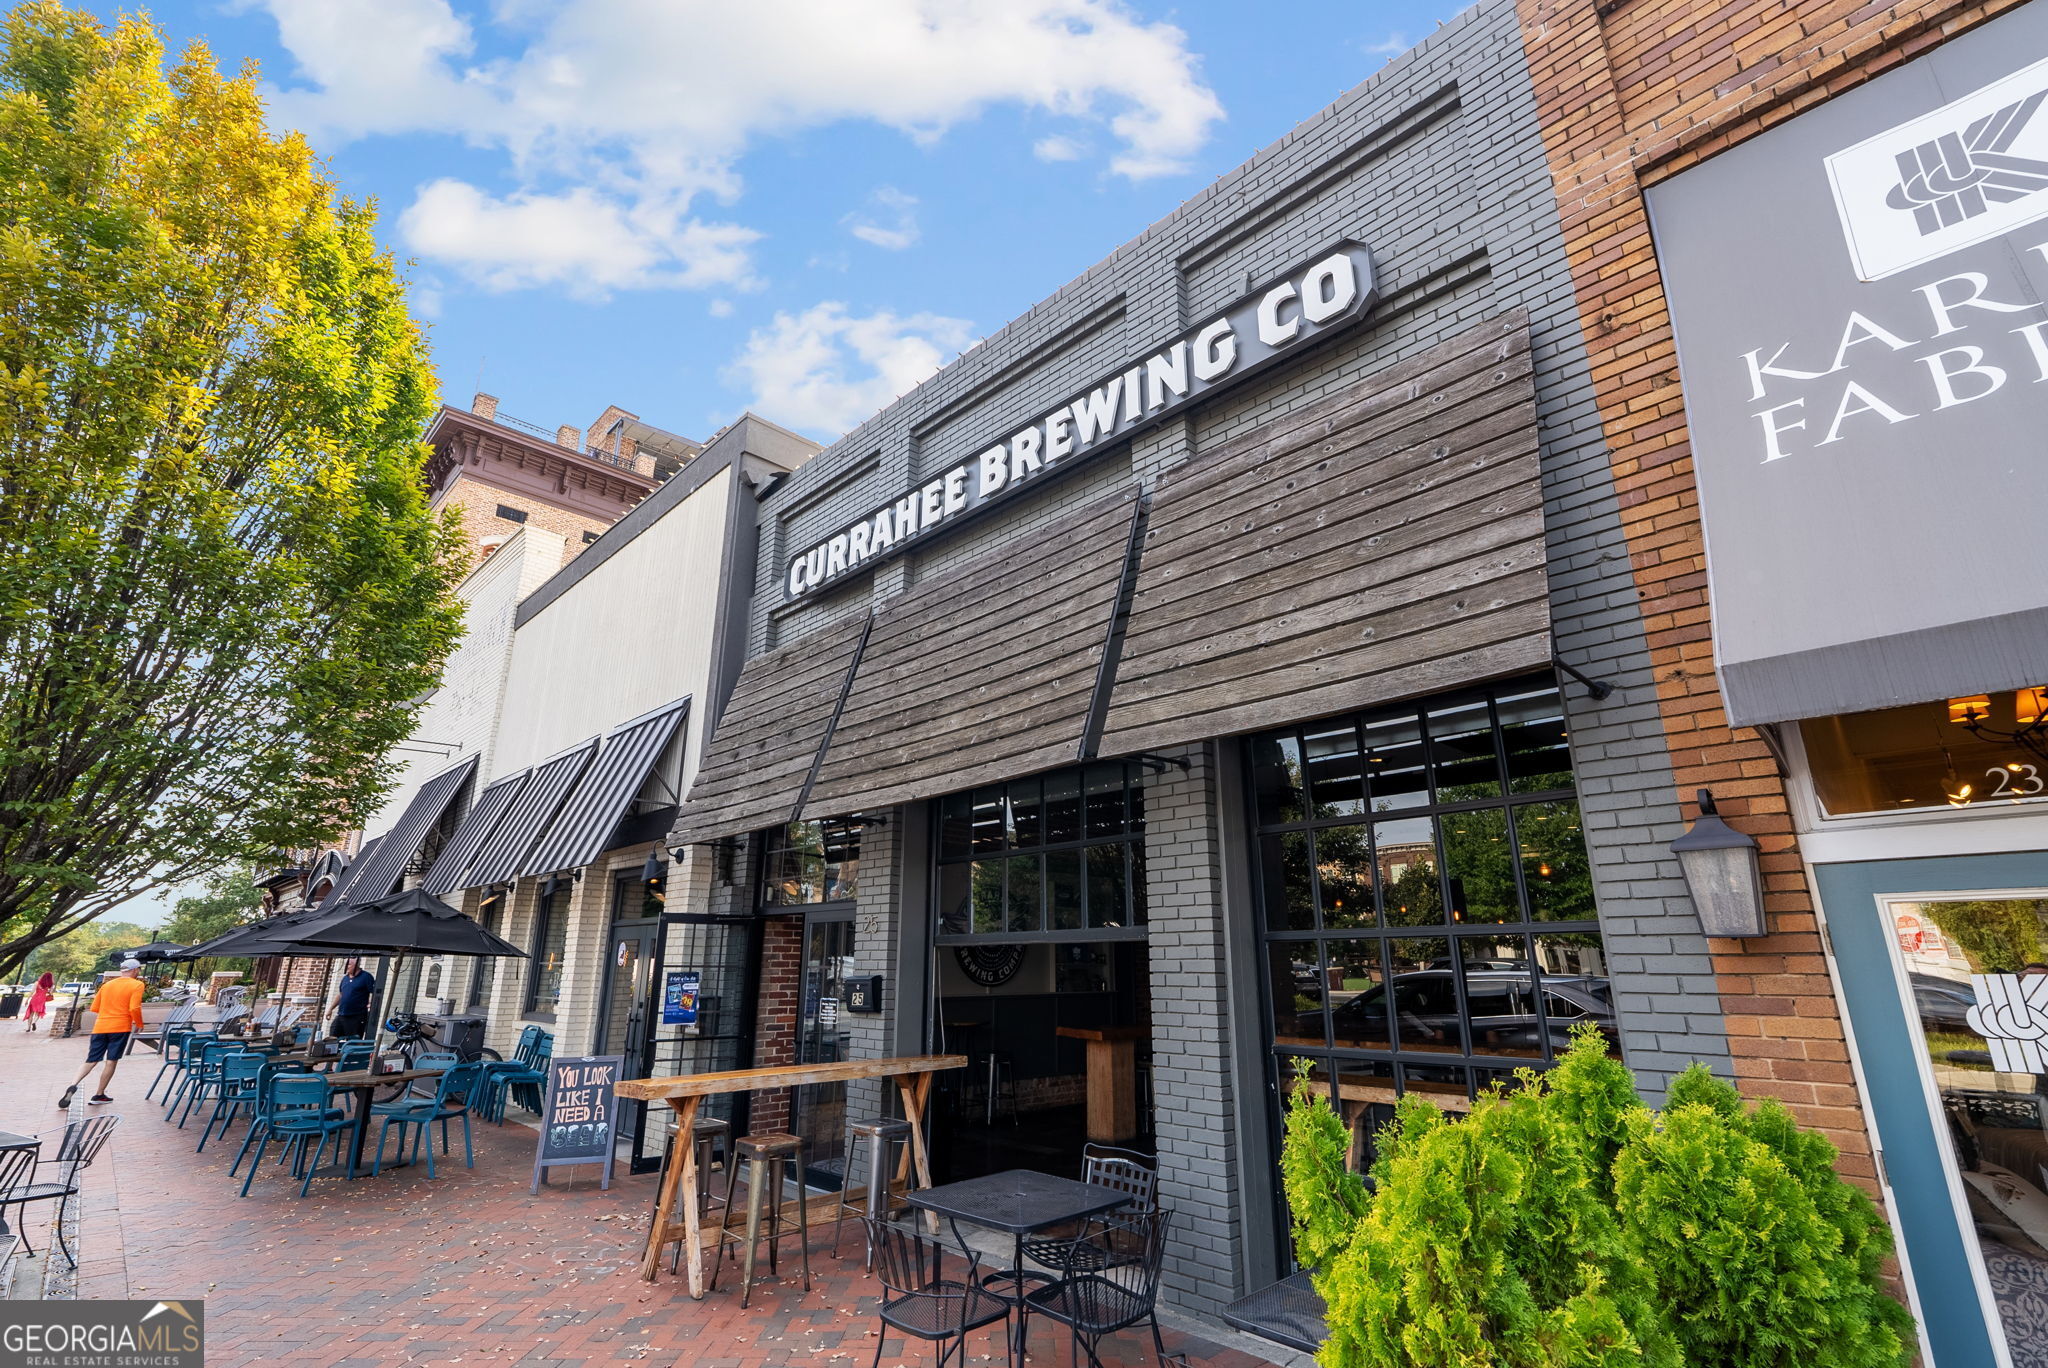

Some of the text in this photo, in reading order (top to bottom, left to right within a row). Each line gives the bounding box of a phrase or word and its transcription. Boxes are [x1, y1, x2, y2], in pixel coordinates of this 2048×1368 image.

[789, 253, 1357, 595] CURRAHEE BREWING CO
[1985, 765, 2044, 797] 23
[863, 915, 879, 934] 25
[960, 947, 994, 981] REWING
[852, 993, 864, 1005] 25
[558, 1066, 613, 1088] YOU LOOK
[556, 1088, 604, 1107] LIKE I
[553, 1105, 605, 1124] NEED A
[550, 1122, 609, 1148] BEER
